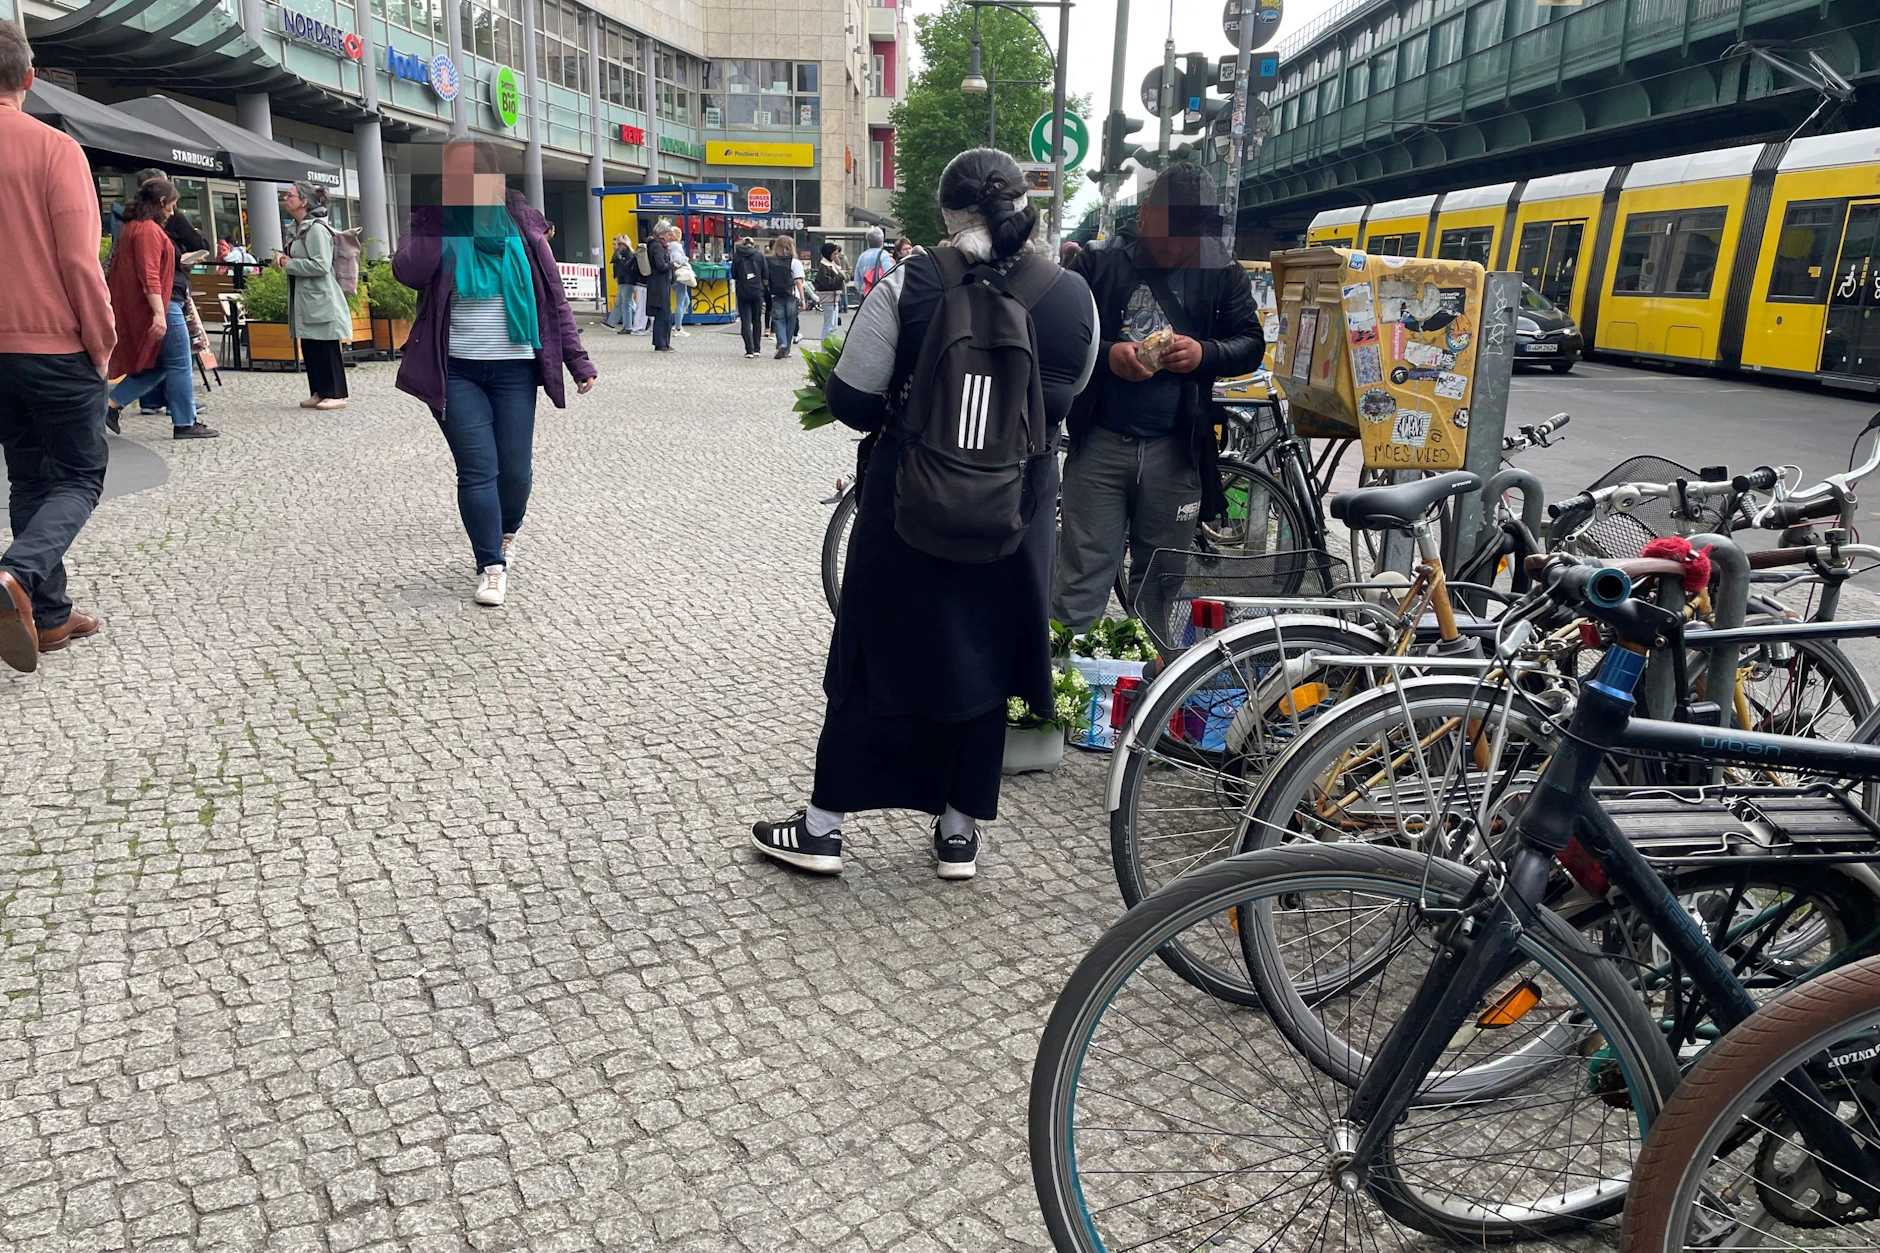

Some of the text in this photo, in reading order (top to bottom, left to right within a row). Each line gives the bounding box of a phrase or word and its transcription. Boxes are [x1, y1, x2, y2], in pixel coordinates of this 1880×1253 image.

[283, 8, 344, 51] NORDSEE
[388, 45, 429, 84] Apollo
[621, 124, 645, 146] REWE
[1042, 117, 1079, 166] S
[172, 148, 215, 168] STARBUCKS
[307, 170, 340, 184] STARBUCKS
[771, 217, 804, 230] KING
[1701, 735, 1782, 757] urban
[1375, 867, 1452, 890] SCHWABE
